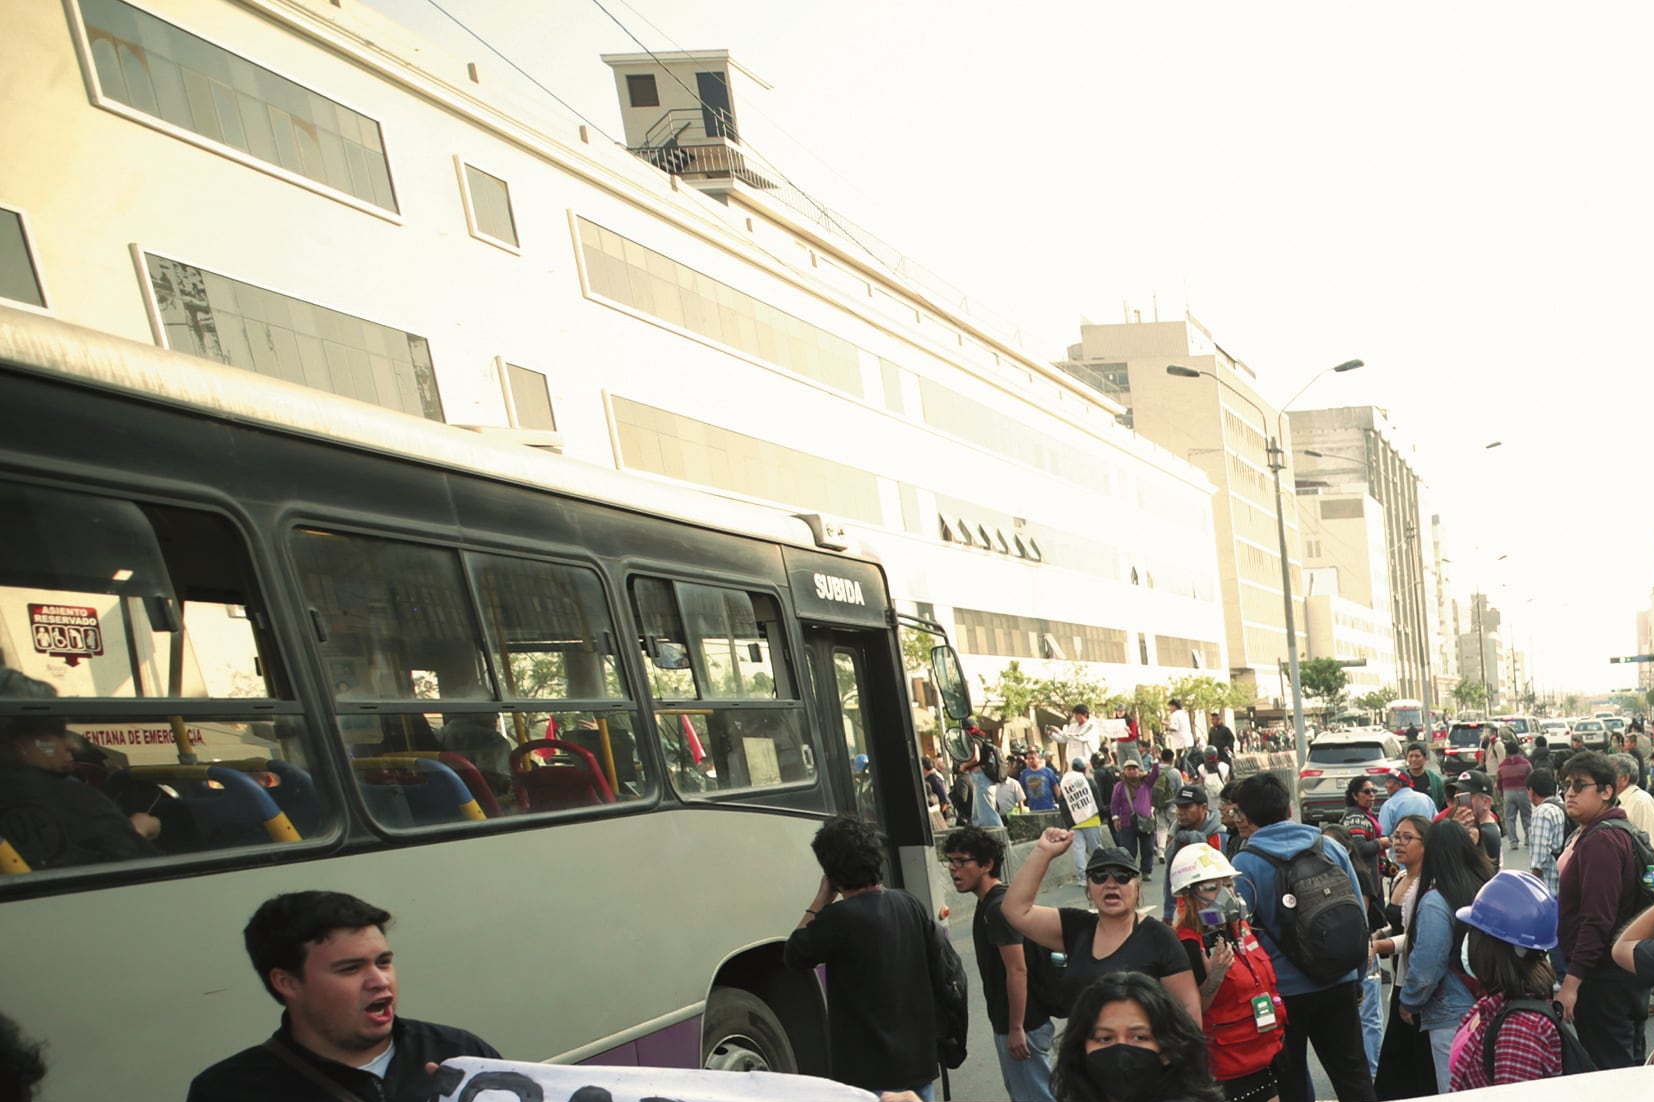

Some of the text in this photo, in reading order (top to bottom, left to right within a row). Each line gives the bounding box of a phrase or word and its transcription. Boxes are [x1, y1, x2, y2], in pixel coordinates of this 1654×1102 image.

[814, 573, 865, 606] SUBIDA
[41, 606, 88, 617] ASIENTO
[34, 615, 97, 626] RESERVADO
[83, 730, 204, 745] ENTANA DE EMERGCIA
